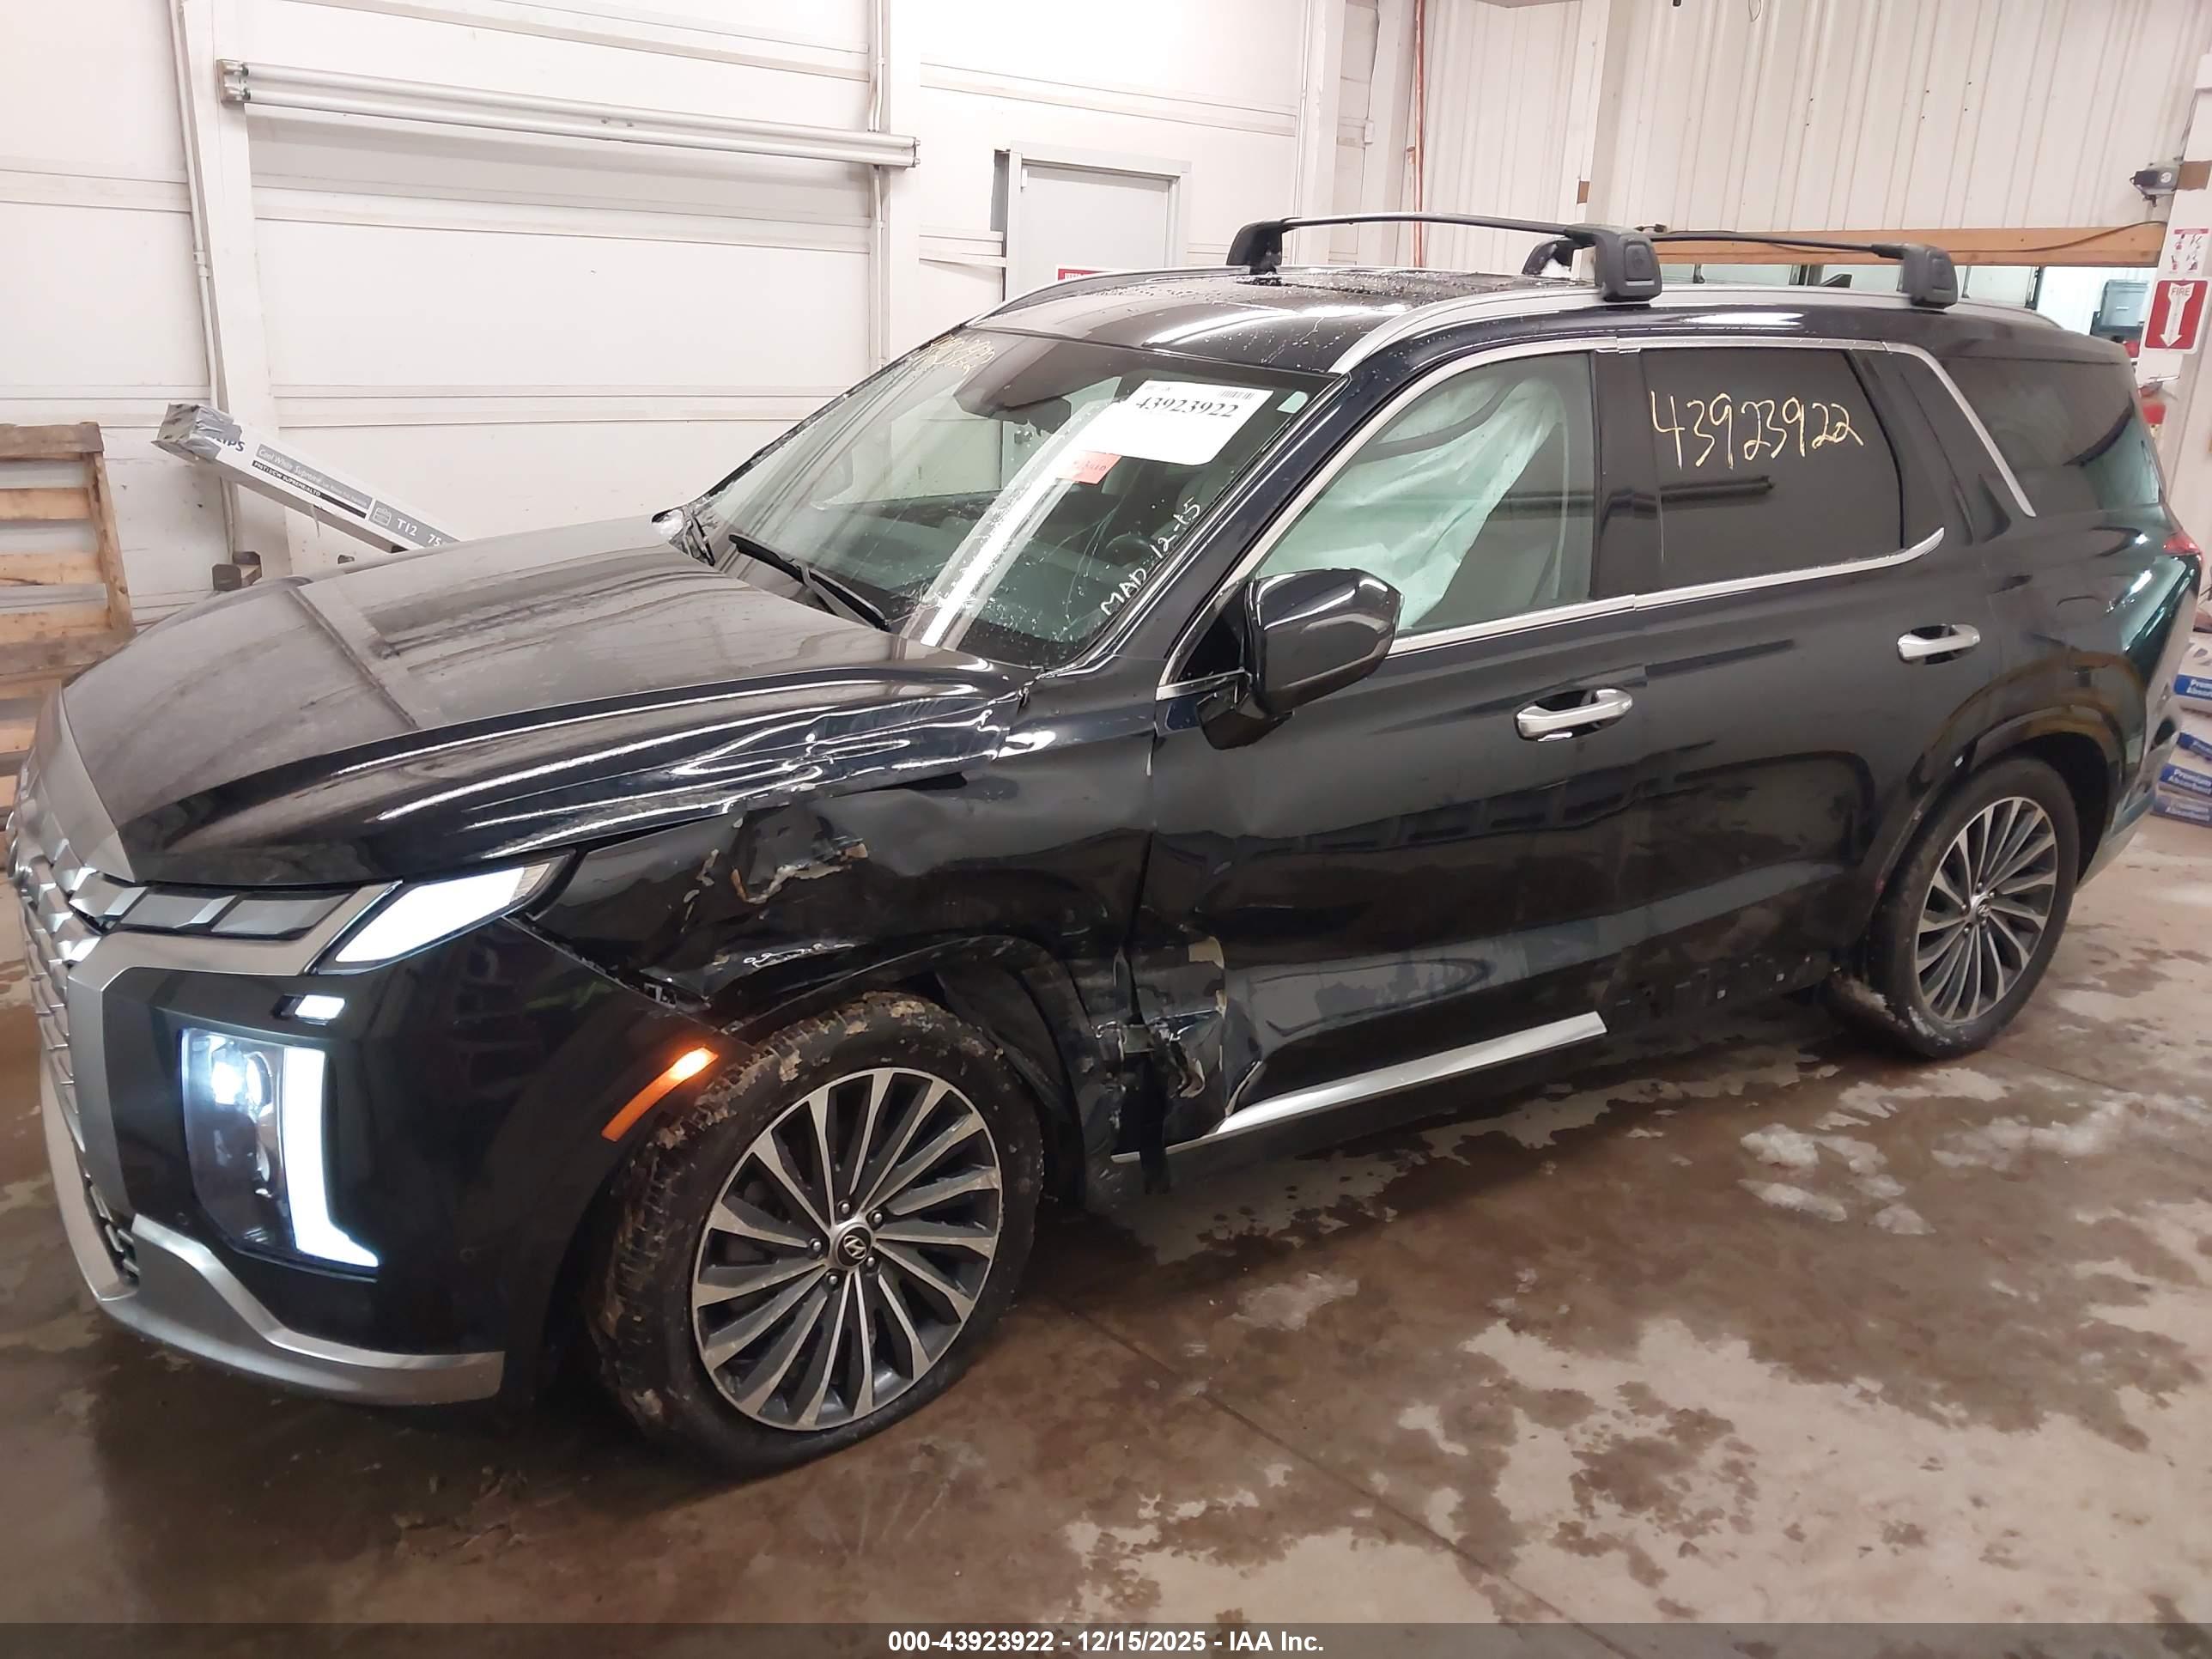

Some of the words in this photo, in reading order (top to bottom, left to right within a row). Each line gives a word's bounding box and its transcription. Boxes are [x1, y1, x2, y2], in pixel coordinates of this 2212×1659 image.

[2170, 287, 2191, 296] FIRE
[1135, 396, 1239, 417] 43923922
[1650, 390, 1865, 471] 43923922
[397, 518, 419, 537] T12
[1100, 568, 1147, 616] MAD
